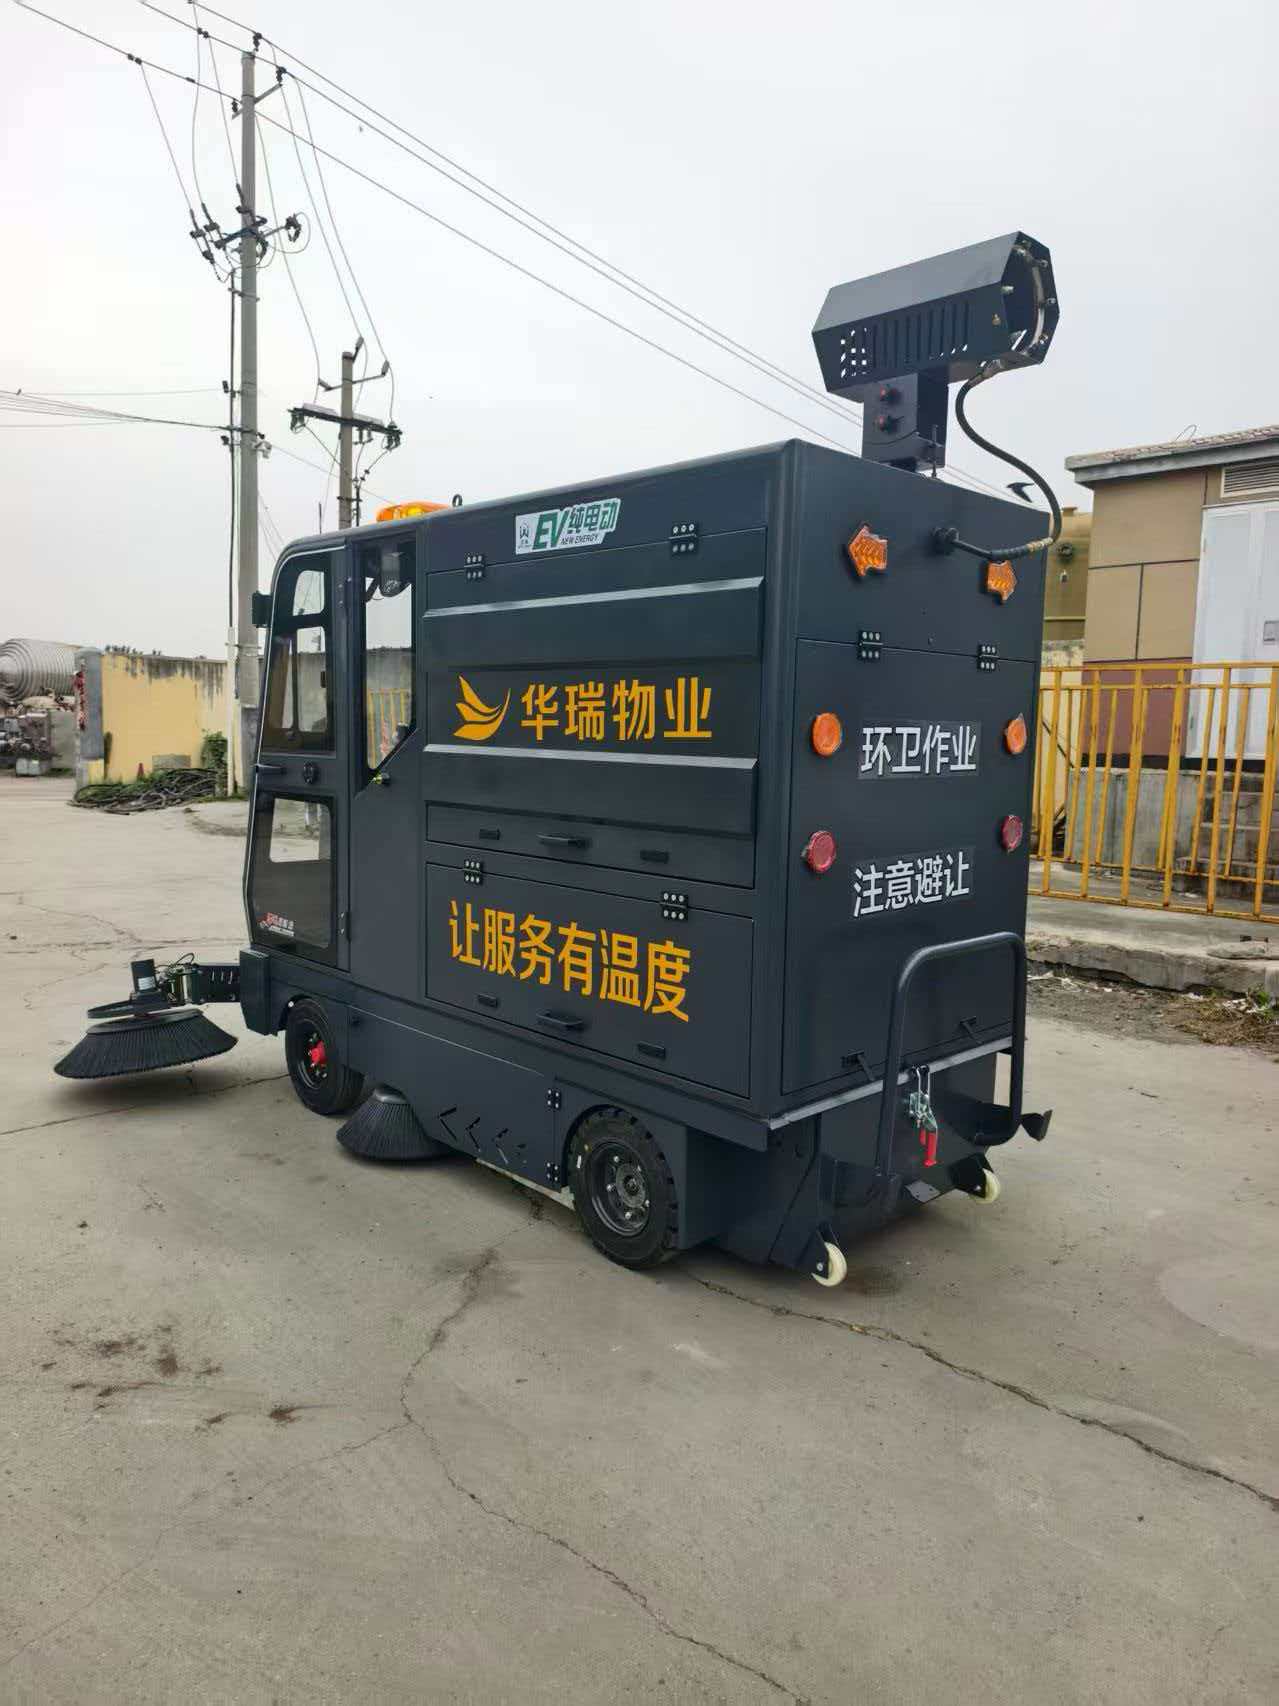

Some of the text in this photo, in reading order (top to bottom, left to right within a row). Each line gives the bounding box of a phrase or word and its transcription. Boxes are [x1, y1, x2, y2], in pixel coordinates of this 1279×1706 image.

[533, 501, 618, 550] EV 纯电动
[575, 535, 598, 544] ENERGY
[520, 677, 712, 741] 华瑞物业
[860, 724, 977, 776] 环卫作业
[853, 851, 970, 918] 注意避让
[449, 900, 691, 1022] 让服务有温度
